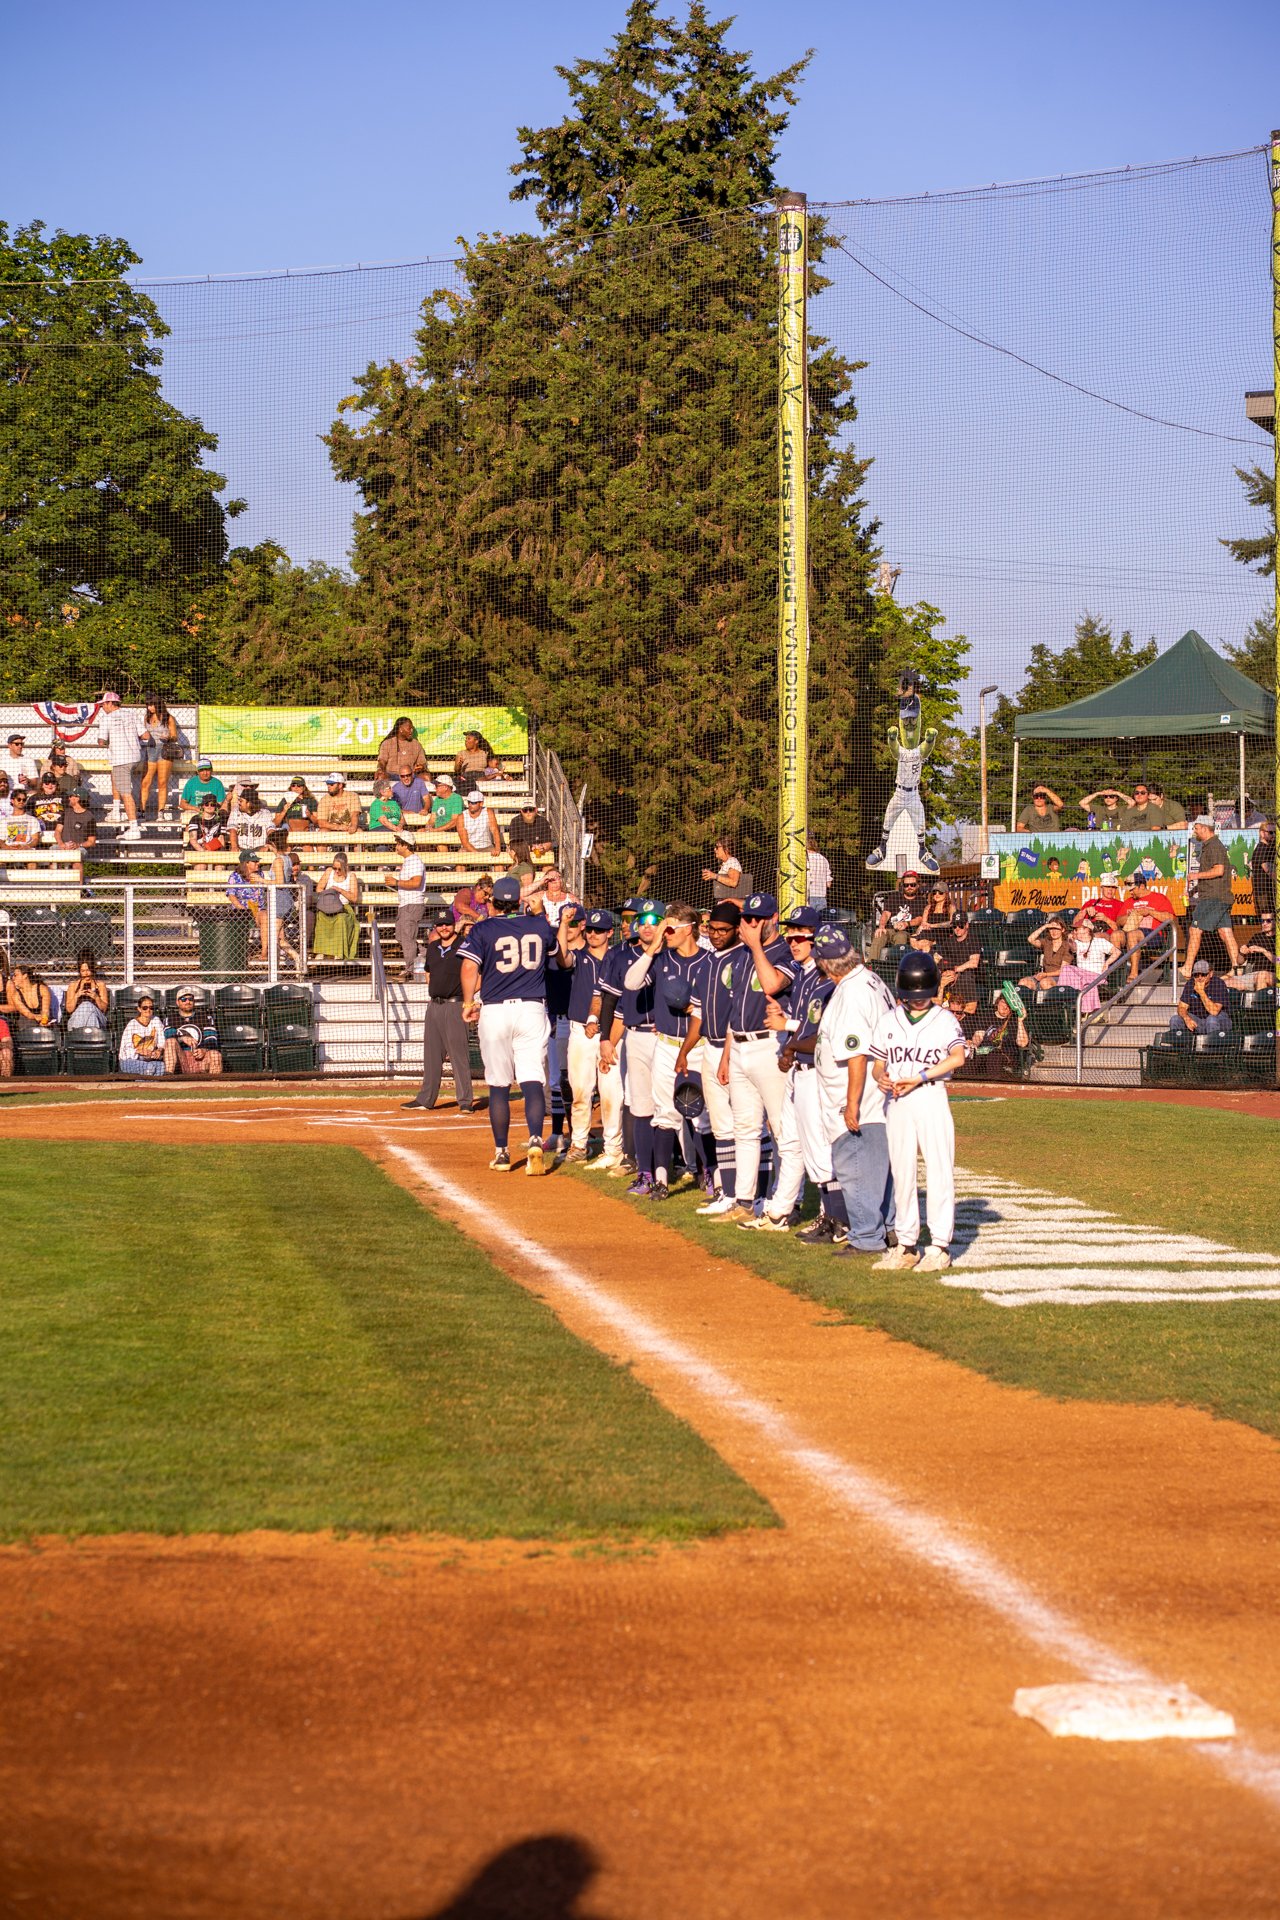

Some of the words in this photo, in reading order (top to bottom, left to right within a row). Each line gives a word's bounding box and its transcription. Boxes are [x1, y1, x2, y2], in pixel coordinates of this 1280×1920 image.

[781, 426, 793, 500] SHOT
[784, 608, 798, 731] ORIGINAL
[784, 736, 797, 788] THE
[1027, 888, 1069, 909] Plywood
[1081, 886, 1126, 907] PAY
[494, 933, 543, 973] 30
[886, 1046, 942, 1065] ICKLES
